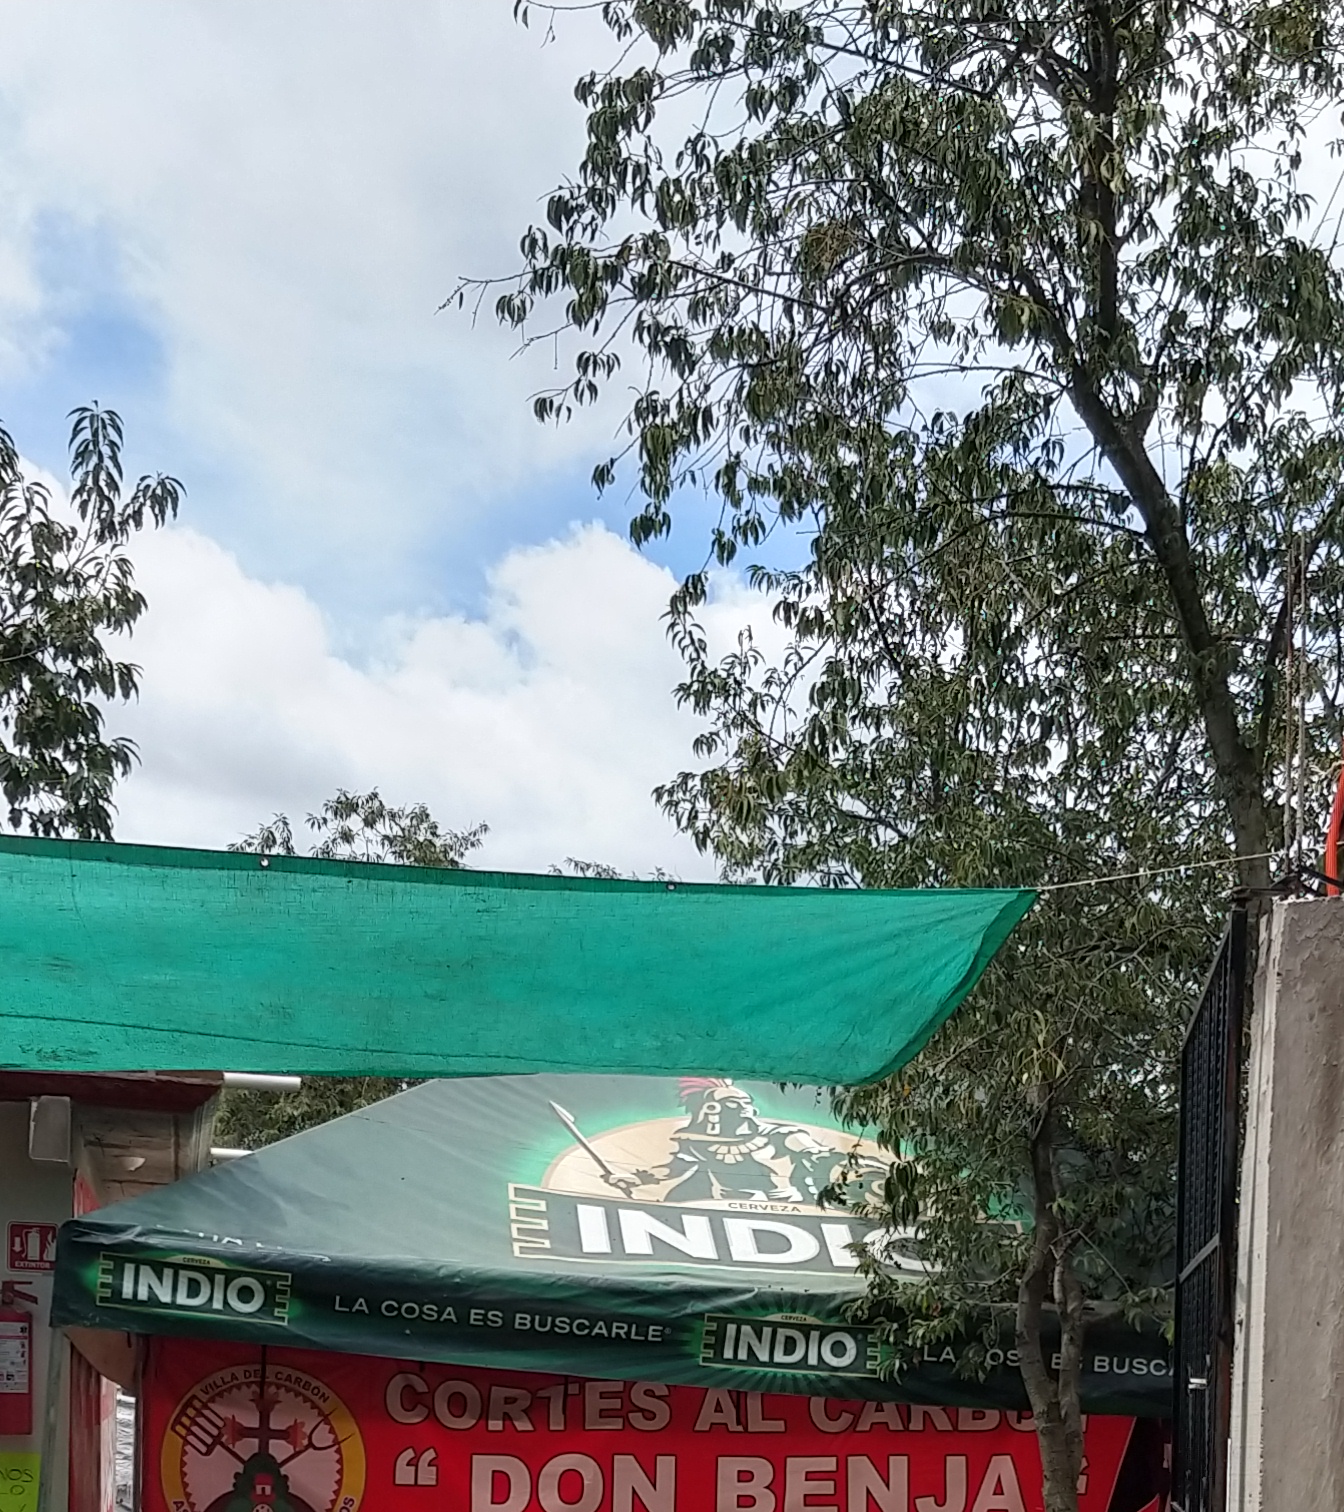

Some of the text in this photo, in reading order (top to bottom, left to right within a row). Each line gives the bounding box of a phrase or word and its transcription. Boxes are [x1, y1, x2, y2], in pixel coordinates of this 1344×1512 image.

[728, 1201, 801, 1214] CERVEZA
[576, 1203, 945, 1273] INDIO
[14, 1260, 51, 1269] EXTINTOR
[121, 1262, 265, 1314] INDIO
[334, 1295, 369, 1314] LA
[381, 1300, 458, 1323] COSA
[469, 1308, 503, 1327] ES
[723, 1323, 857, 1368] INDIO
[1093, 1355, 1175, 1376] BUSC
[199, 1371, 240, 1396] VILLA
[274, 1371, 330, 1404] CARBÓN
[385, 1372, 673, 1432] CORTES
[694, 1386, 787, 1433] AL
